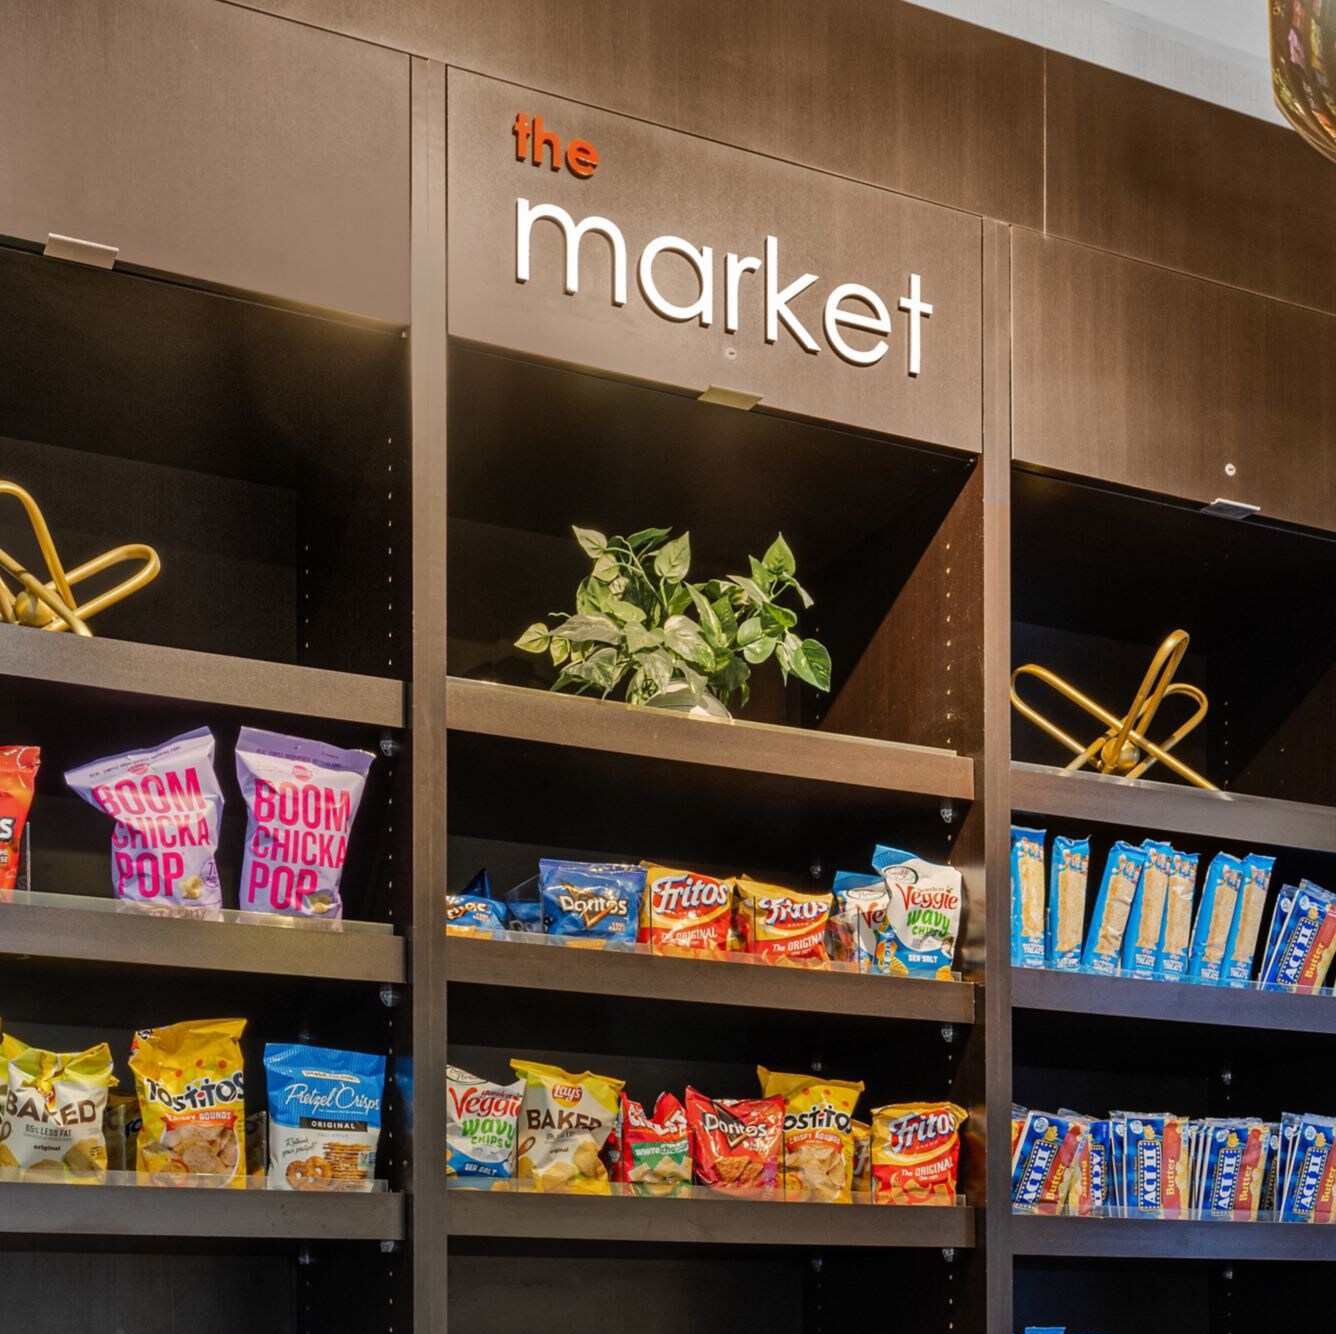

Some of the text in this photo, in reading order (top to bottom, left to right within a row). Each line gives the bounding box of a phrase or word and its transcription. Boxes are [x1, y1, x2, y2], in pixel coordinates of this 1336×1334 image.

[512, 112, 599, 179] the
[515, 197, 934, 377] market
[92, 768, 207, 817] BOOM
[254, 778, 350, 833] BOOM
[112, 813, 210, 849] CHICKA
[252, 825, 347, 869] CHICKA
[115, 852, 184, 898] POP
[248, 860, 318, 911] POP
[559, 896, 628, 915] Doritos
[651, 874, 728, 915] Fritos
[895, 883, 958, 911] Veggie
[907, 909, 950, 937] wavy
[1285, 945, 1305, 980] ACT
[1304, 943, 1324, 978] Butter
[284, 1082, 380, 1115] Pretzel Crisps
[553, 1084, 581, 1101] Lay's
[41, 1127, 59, 1137] LESS
[60, 1129, 72, 1137] FAT
[311, 1120, 355, 1129] ORIGINAL
[462, 1118, 514, 1149] wavy
[526, 1109, 602, 1131] BAKED
[704, 1113, 767, 1137] Doritos
[471, 1135, 503, 1148] CHIPS
[789, 1133, 812, 1144] CRISPY
[480, 1166, 497, 1176] SALT
[915, 1157, 954, 1176] ORIGINAL
[1046, 1162, 1066, 1200] Butter
[1166, 1157, 1176, 1196] Butter
[1239, 1165, 1252, 1201] Butter
[1023, 1170, 1043, 1204] ACT
[1143, 1170, 1156, 1204] ACT
[1218, 1177, 1233, 1209] ACT
[1300, 1176, 1317, 1208] ACT
[1321, 1166, 1336, 1202] Butter
